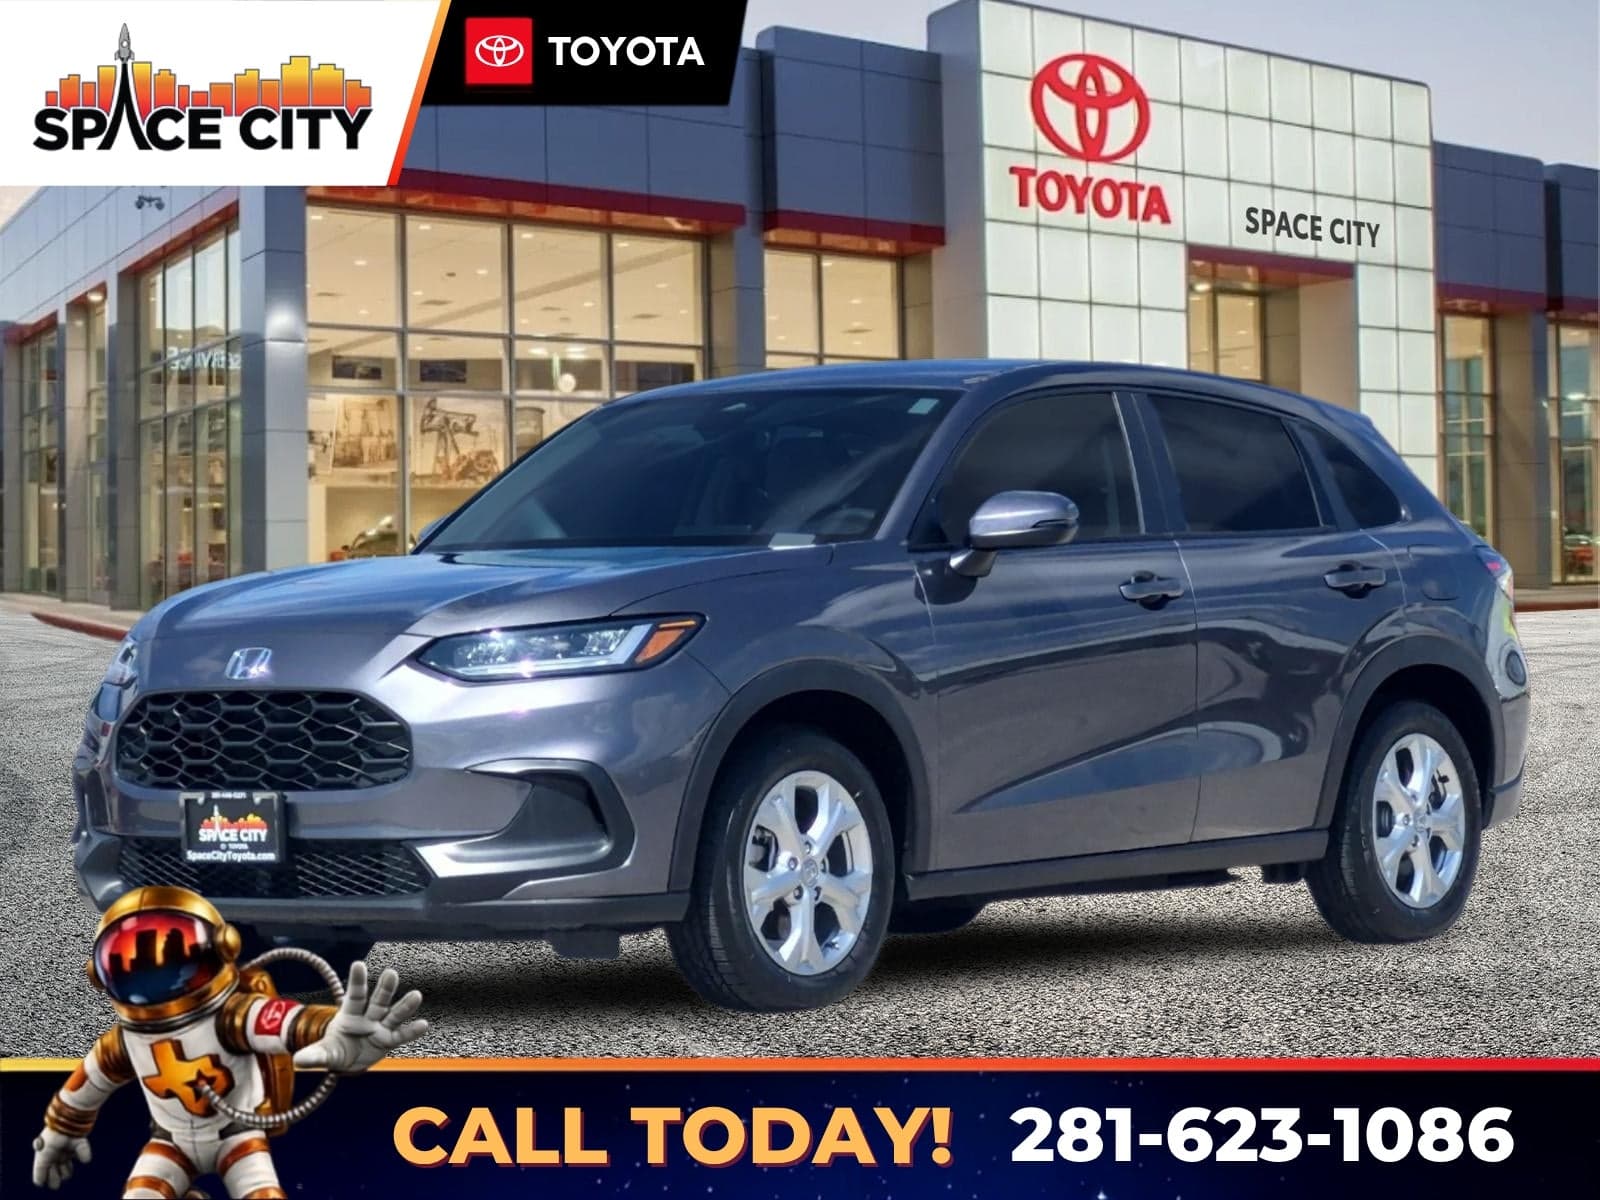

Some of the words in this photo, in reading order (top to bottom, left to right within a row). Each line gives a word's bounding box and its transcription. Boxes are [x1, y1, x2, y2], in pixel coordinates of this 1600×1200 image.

[1008, 166, 1171, 224] TOYOTA
[1245, 206, 1323, 242] SPACE
[1329, 218, 1381, 248] CITY
[198, 828, 239, 842] SPACE
[239, 828, 268, 842] CITY
[186, 850, 276, 862] SpaceCityToyota.com
